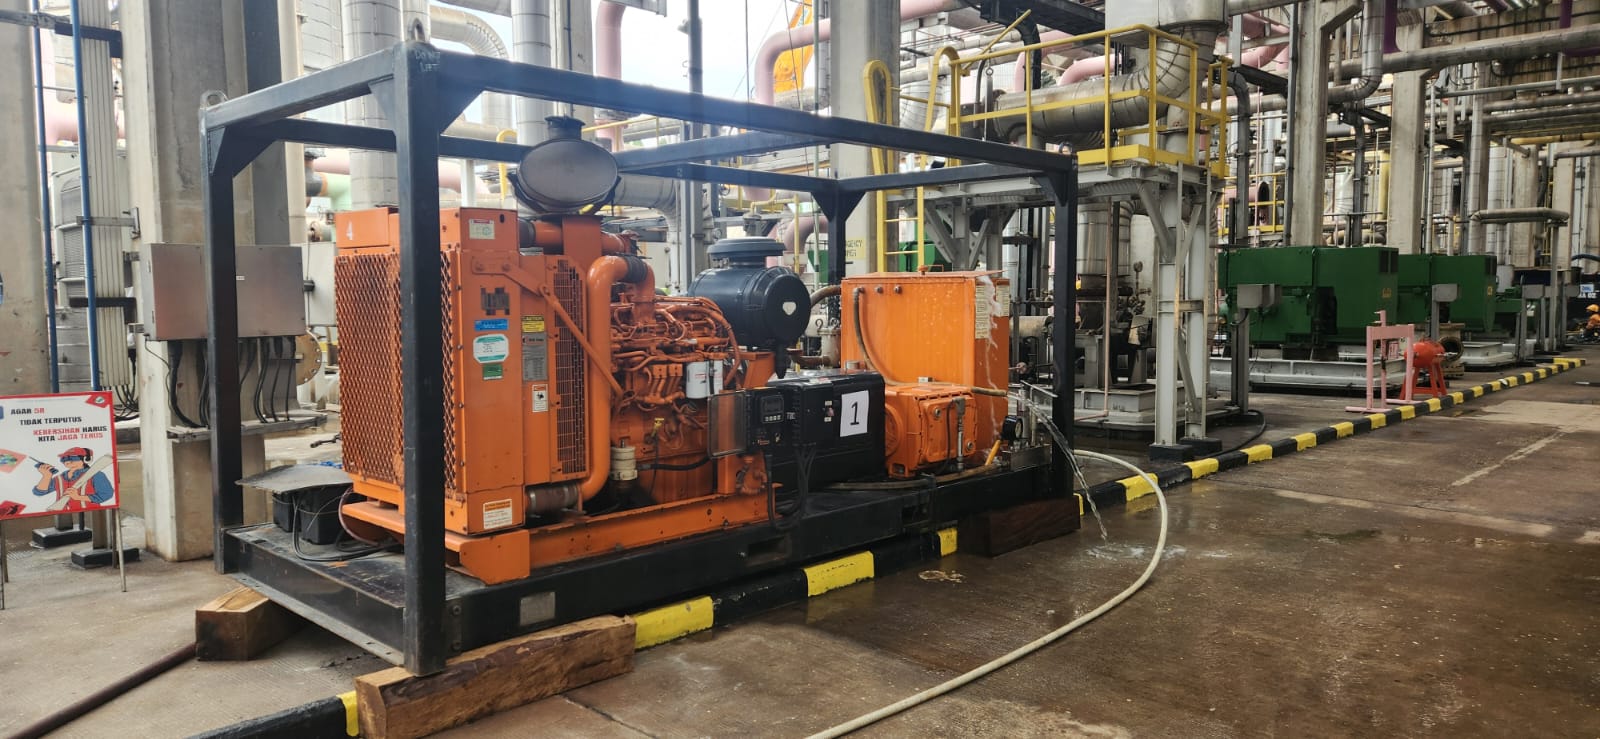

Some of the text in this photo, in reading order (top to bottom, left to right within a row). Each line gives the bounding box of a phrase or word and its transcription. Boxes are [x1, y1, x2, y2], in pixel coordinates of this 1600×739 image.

[346, 220, 353, 241] 4
[20, 416, 82, 426] TIDAK TERPUTUS
[850, 401, 860, 425] 1
[33, 425, 107, 436] KEBERSIHAN HARUS
